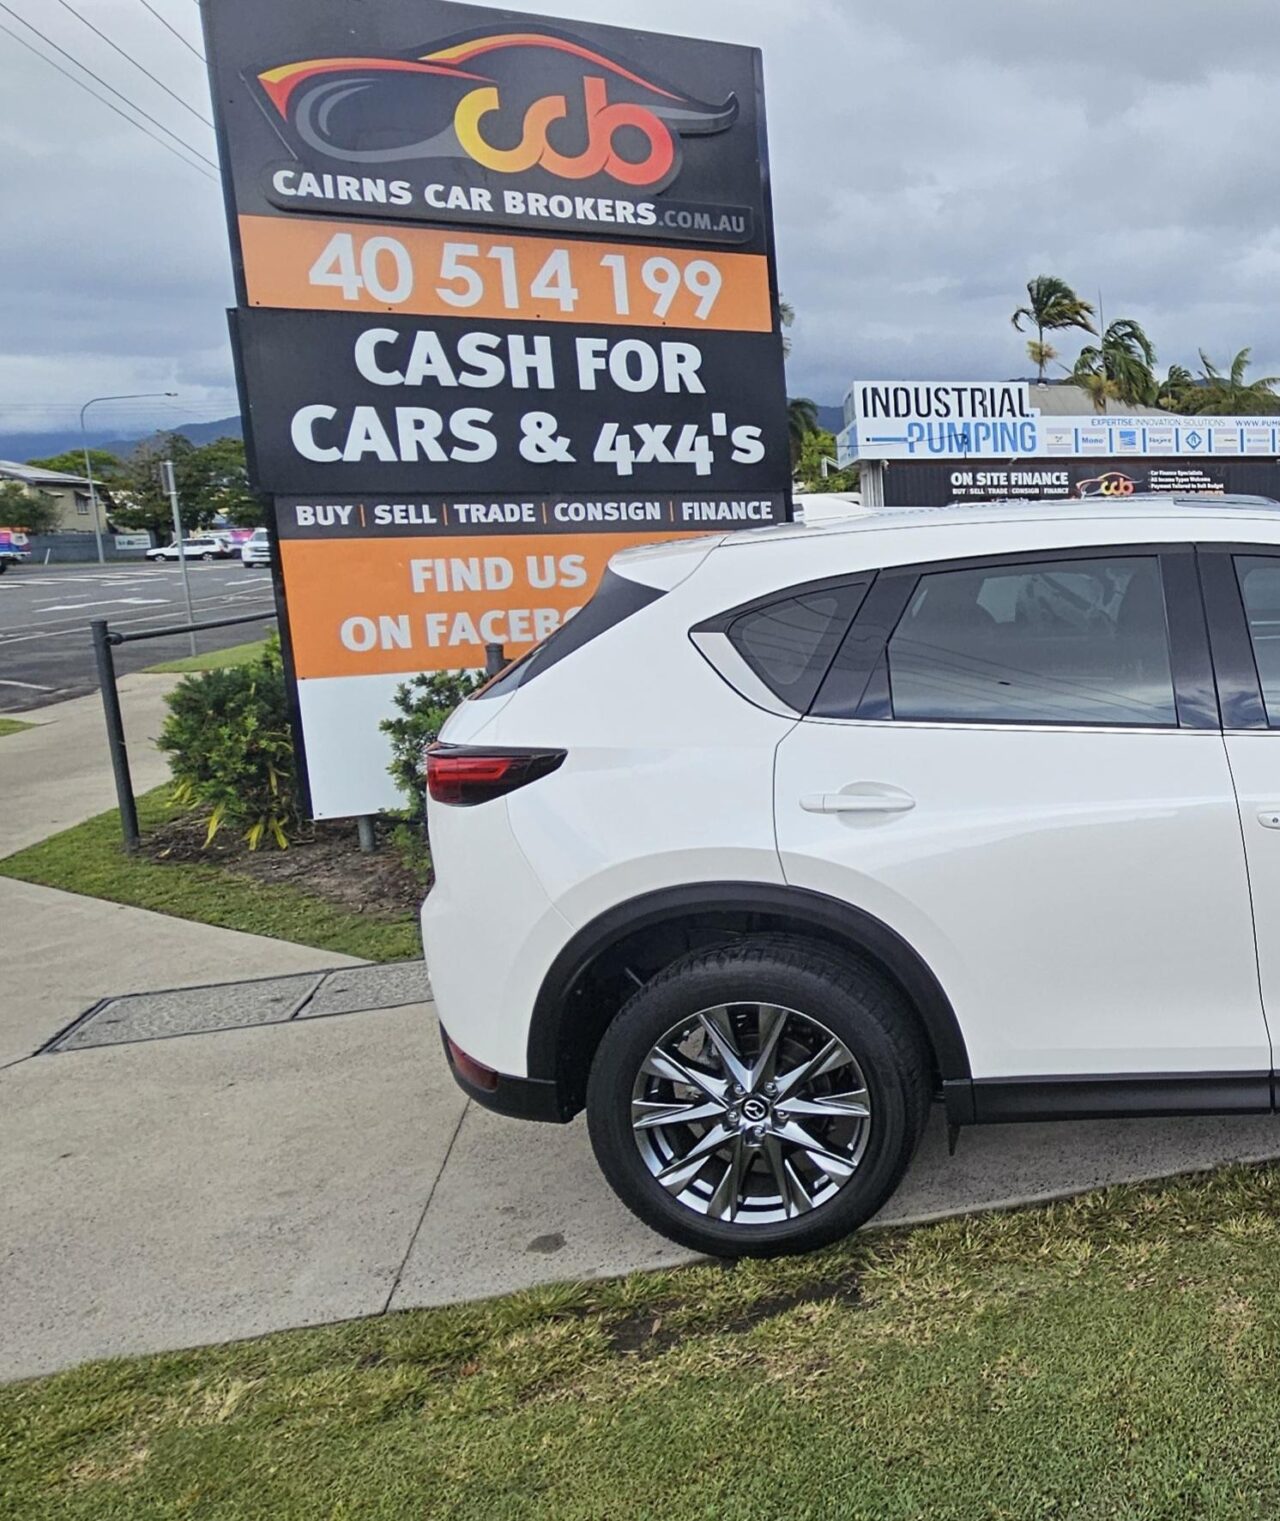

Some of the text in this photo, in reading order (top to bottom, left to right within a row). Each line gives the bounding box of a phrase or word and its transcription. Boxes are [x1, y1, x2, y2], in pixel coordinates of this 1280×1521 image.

[272, 170, 412, 204] CAIRNS
[424, 183, 493, 211] CAR
[309, 233, 722, 320] 40 514 199
[354, 327, 706, 394] CASH FOR
[290, 404, 498, 463] CARS
[518, 411, 577, 463] &
[907, 421, 1037, 453] PUMPING
[951, 472, 1069, 486] ON SITE FINANCE
[952, 487, 966, 495] BUY
[969, 487, 985, 495] SELL
[988, 487, 1008, 495] TRADE
[1011, 487, 1040, 495] CONSIGN
[296, 500, 774, 526] BUY SELL TRADE CONSIGN FINANCE
[410, 554, 588, 593] FIND US
[340, 614, 413, 653] ON
